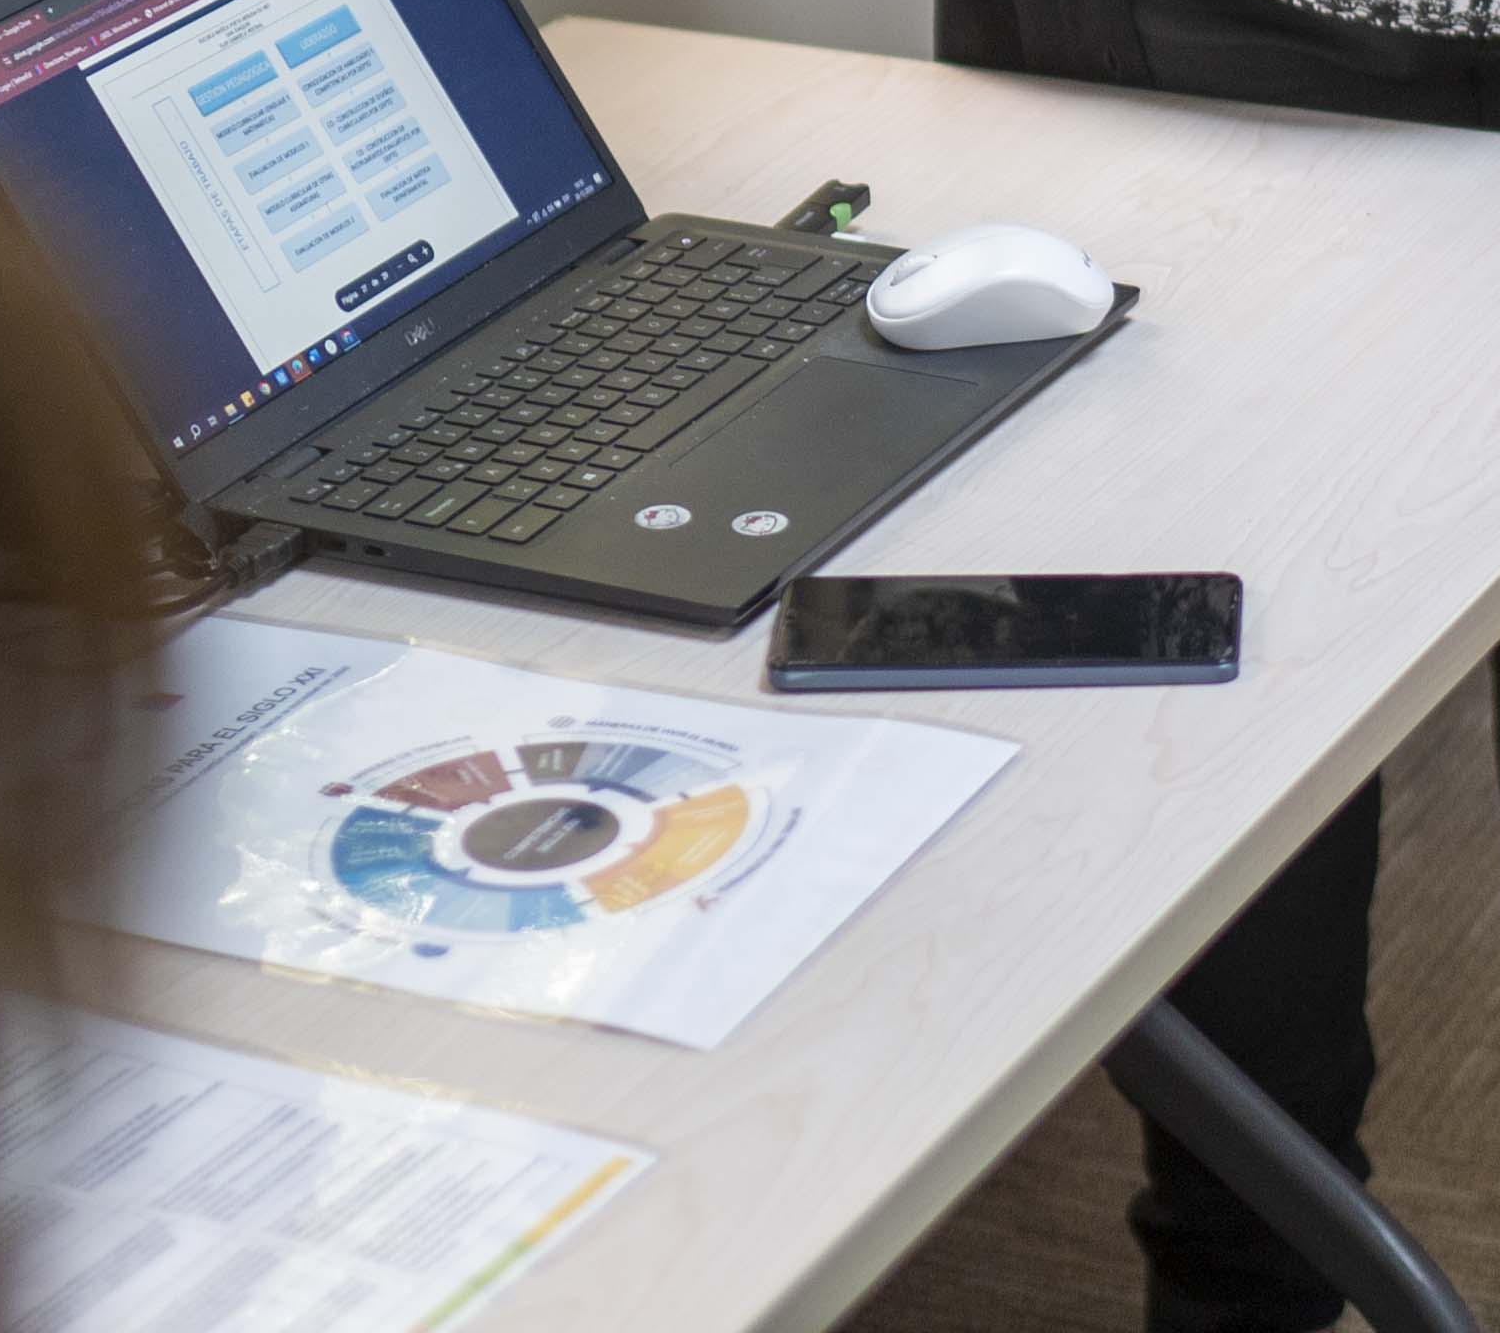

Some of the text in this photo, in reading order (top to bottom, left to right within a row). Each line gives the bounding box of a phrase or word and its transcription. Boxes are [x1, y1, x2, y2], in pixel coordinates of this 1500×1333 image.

[211, 191, 222, 207] DE
[220, 208, 250, 251] ETAPAS
[168, 666, 328, 774] PARA EL SIGLO XXI
